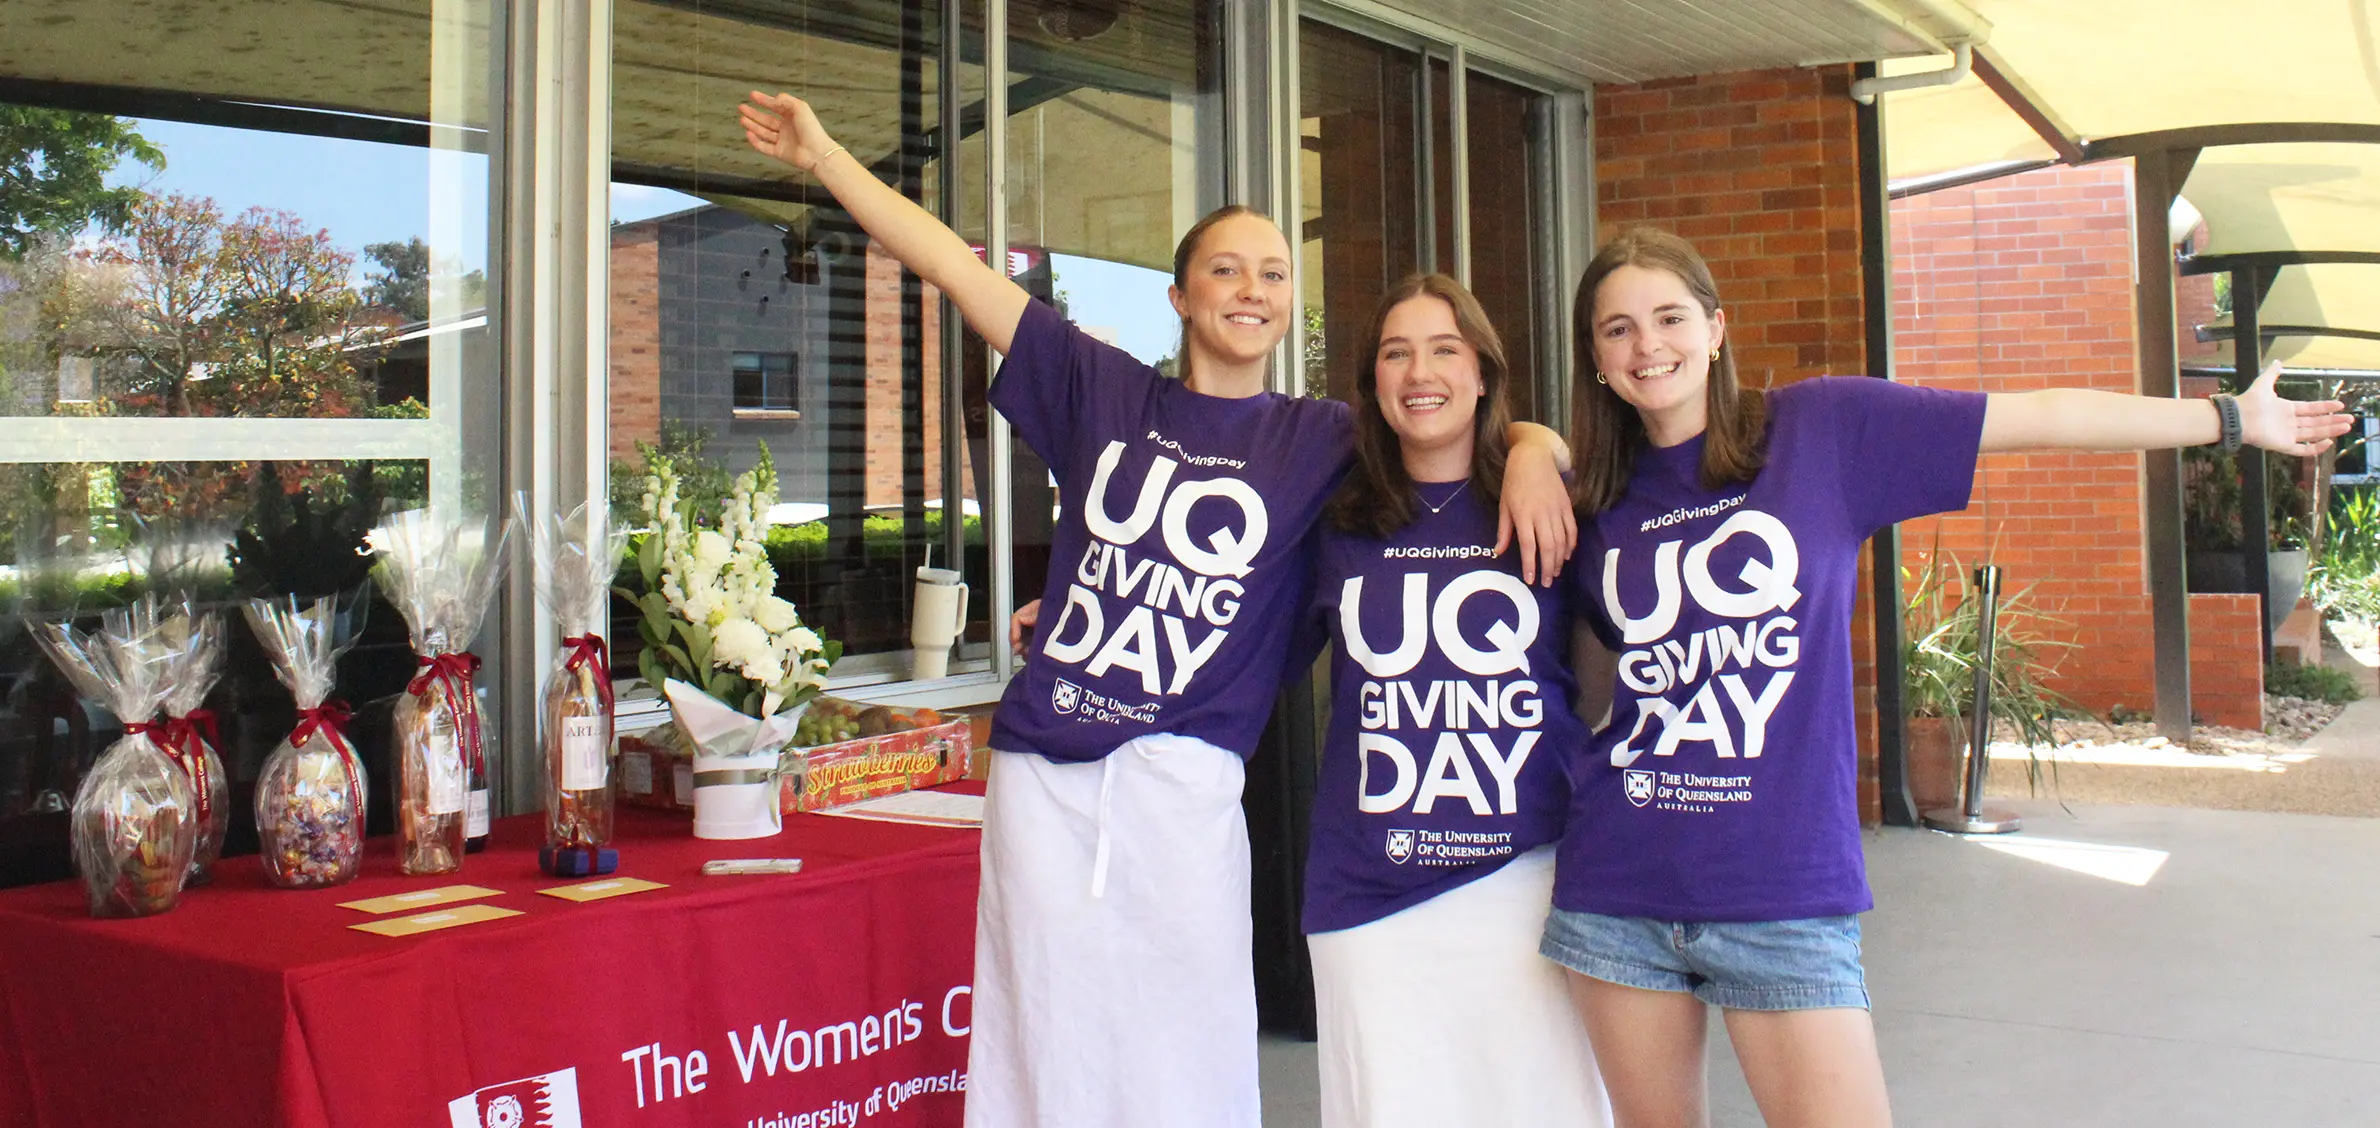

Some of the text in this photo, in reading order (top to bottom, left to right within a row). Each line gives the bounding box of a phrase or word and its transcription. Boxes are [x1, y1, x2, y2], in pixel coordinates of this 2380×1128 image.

[1084, 440, 1268, 579] UQ
[1640, 493, 1746, 532] #UQGivingDay
[1077, 540, 1245, 626] GIVING
[1602, 510, 1802, 644] UQ
[1042, 583, 1229, 696] DAY
[1339, 569, 1540, 678] UQ
[1618, 616, 1800, 694] GIVING
[1080, 702, 1096, 716] OF
[1085, 689, 1106, 707] THE
[1360, 680, 1543, 729] GIVING
[807, 742, 937, 795] Strawberries
[1358, 731, 1543, 815] DAY
[1659, 771, 1751, 787] THE UNIVERSITY
[1656, 802, 1715, 813] AUSTRALIA
[1657, 786, 1752, 802] OF QUEENSLAND
[1417, 843, 1512, 858] OF QUEENSLAND
[1418, 830, 1512, 844] THE UNIVERSITY
[621, 1041, 708, 1109] The
[727, 998, 923, 1084] Women's
[865, 1086, 882, 1117] of
